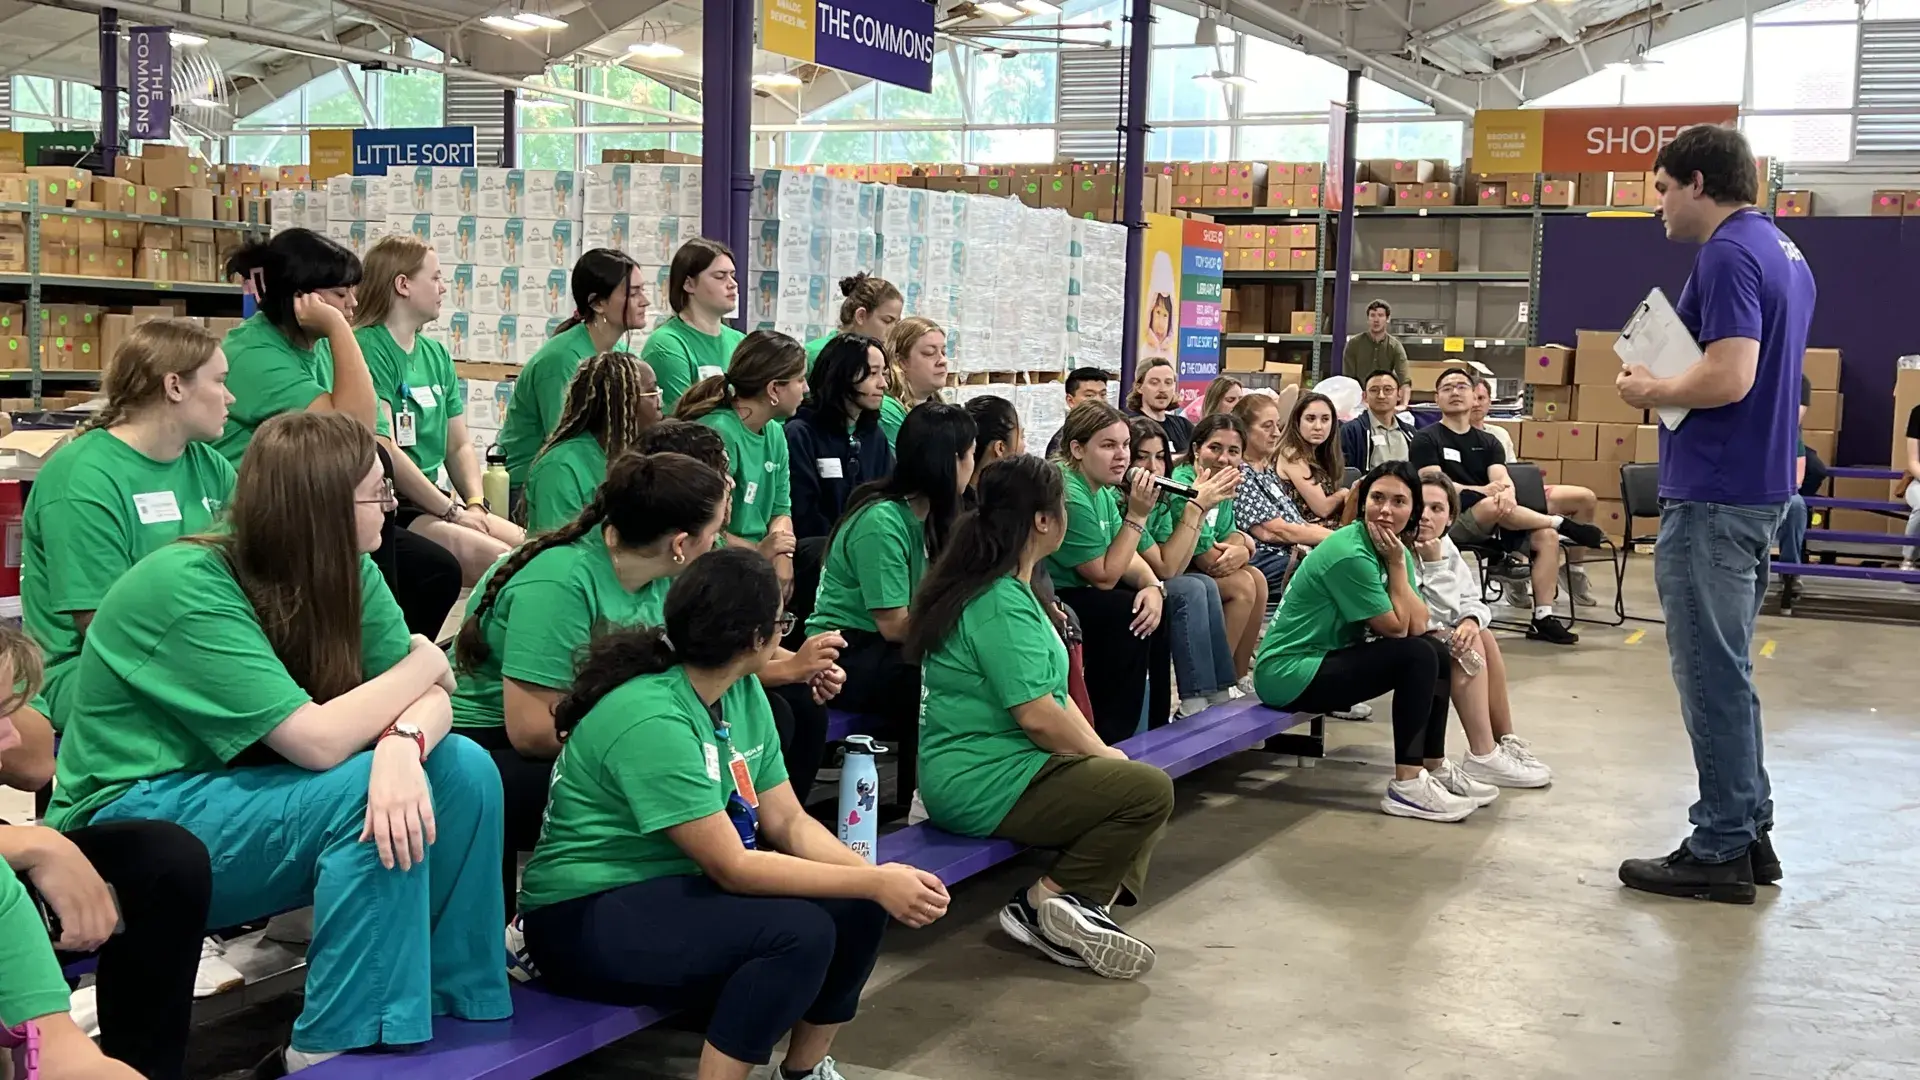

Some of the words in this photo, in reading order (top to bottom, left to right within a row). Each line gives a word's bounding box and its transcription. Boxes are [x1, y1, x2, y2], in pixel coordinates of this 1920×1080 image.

[818, 2, 850, 40] THE
[853, 14, 933, 64] COMMONS
[136, 32, 149, 133] COMMONS
[152, 64, 164, 101] THE
[1587, 125, 1695, 154] SHOE
[357, 144, 417, 165] LITTLE
[422, 143, 473, 164] SORT
[1203, 229, 1218, 243] SHOES
[1195, 255, 1204, 268] TOY
[1204, 256, 1217, 270] SHOP
[1196, 282, 1216, 296] LIBRARY
[1187, 335, 1201, 348] LITTLE
[1201, 336, 1213, 348] SORT
[1187, 362, 1195, 374] THE
[1195, 363, 1217, 375] COMMONS
[851, 841, 870, 851] GIRL
